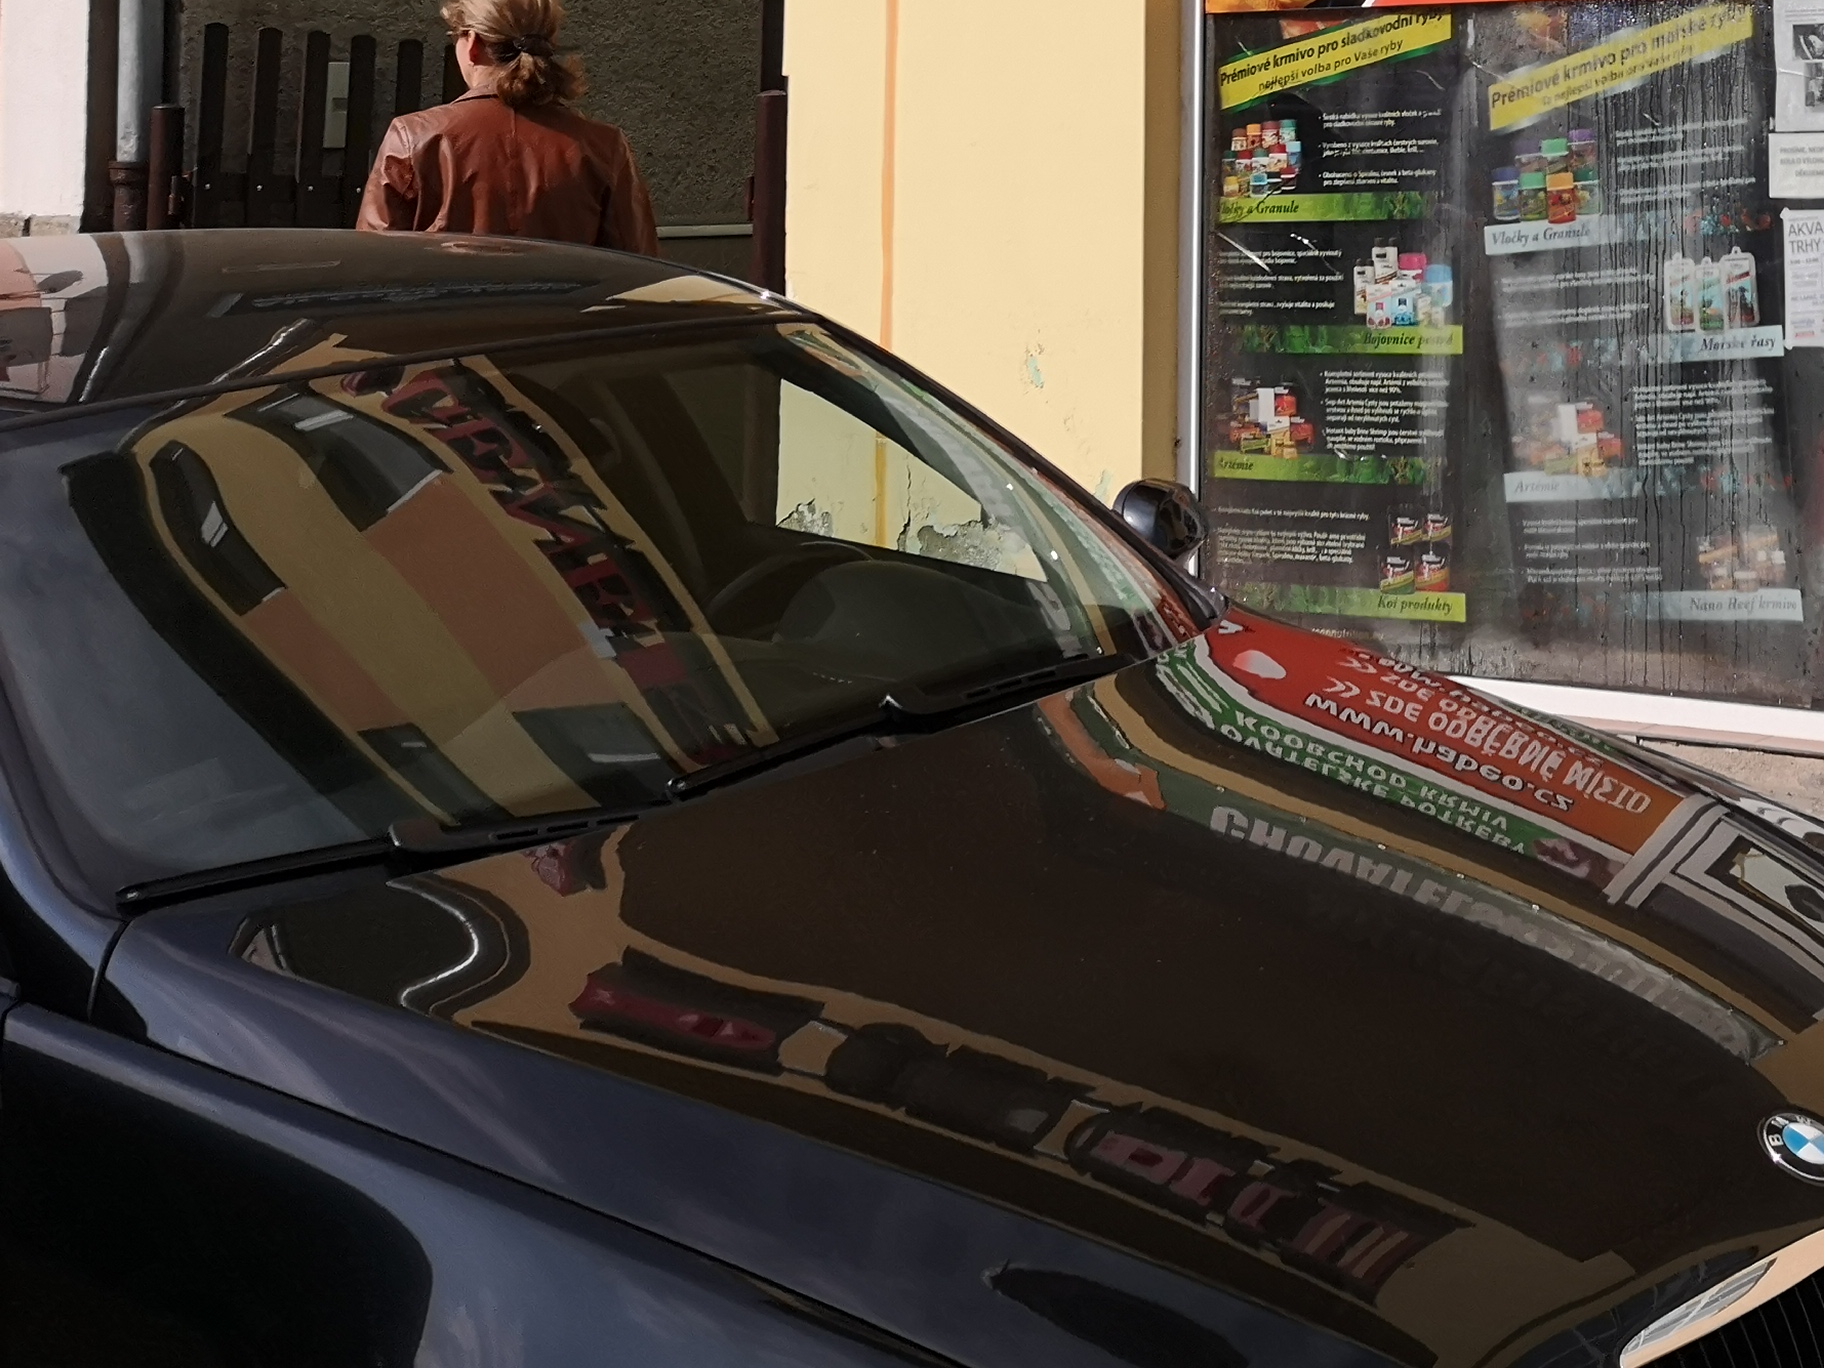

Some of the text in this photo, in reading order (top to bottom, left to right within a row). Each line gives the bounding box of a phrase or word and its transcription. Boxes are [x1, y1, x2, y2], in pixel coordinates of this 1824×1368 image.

[1220, 59, 1271, 87] Prémiové
[1273, 47, 1315, 69] krmivo
[1318, 41, 1338, 61] pro
[1301, 62, 1332, 79] volba
[1334, 56, 1351, 71] pro
[1354, 47, 1379, 63] Vaše
[1380, 38, 1404, 55] ryby
[1491, 72, 1561, 109] Prémiové
[1563, 52, 1617, 79] krmivo
[1255, 199, 1299, 215] Granule
[1491, 229, 1530, 248] Vločky
[1789, 237, 1822, 254] TRHY
[1362, 330, 1415, 350] Bojovnice
[1750, 334, 1776, 351] řasy
[1378, 596, 1453, 615] Koi produkty
[1758, 597, 1798, 612] krmivo
